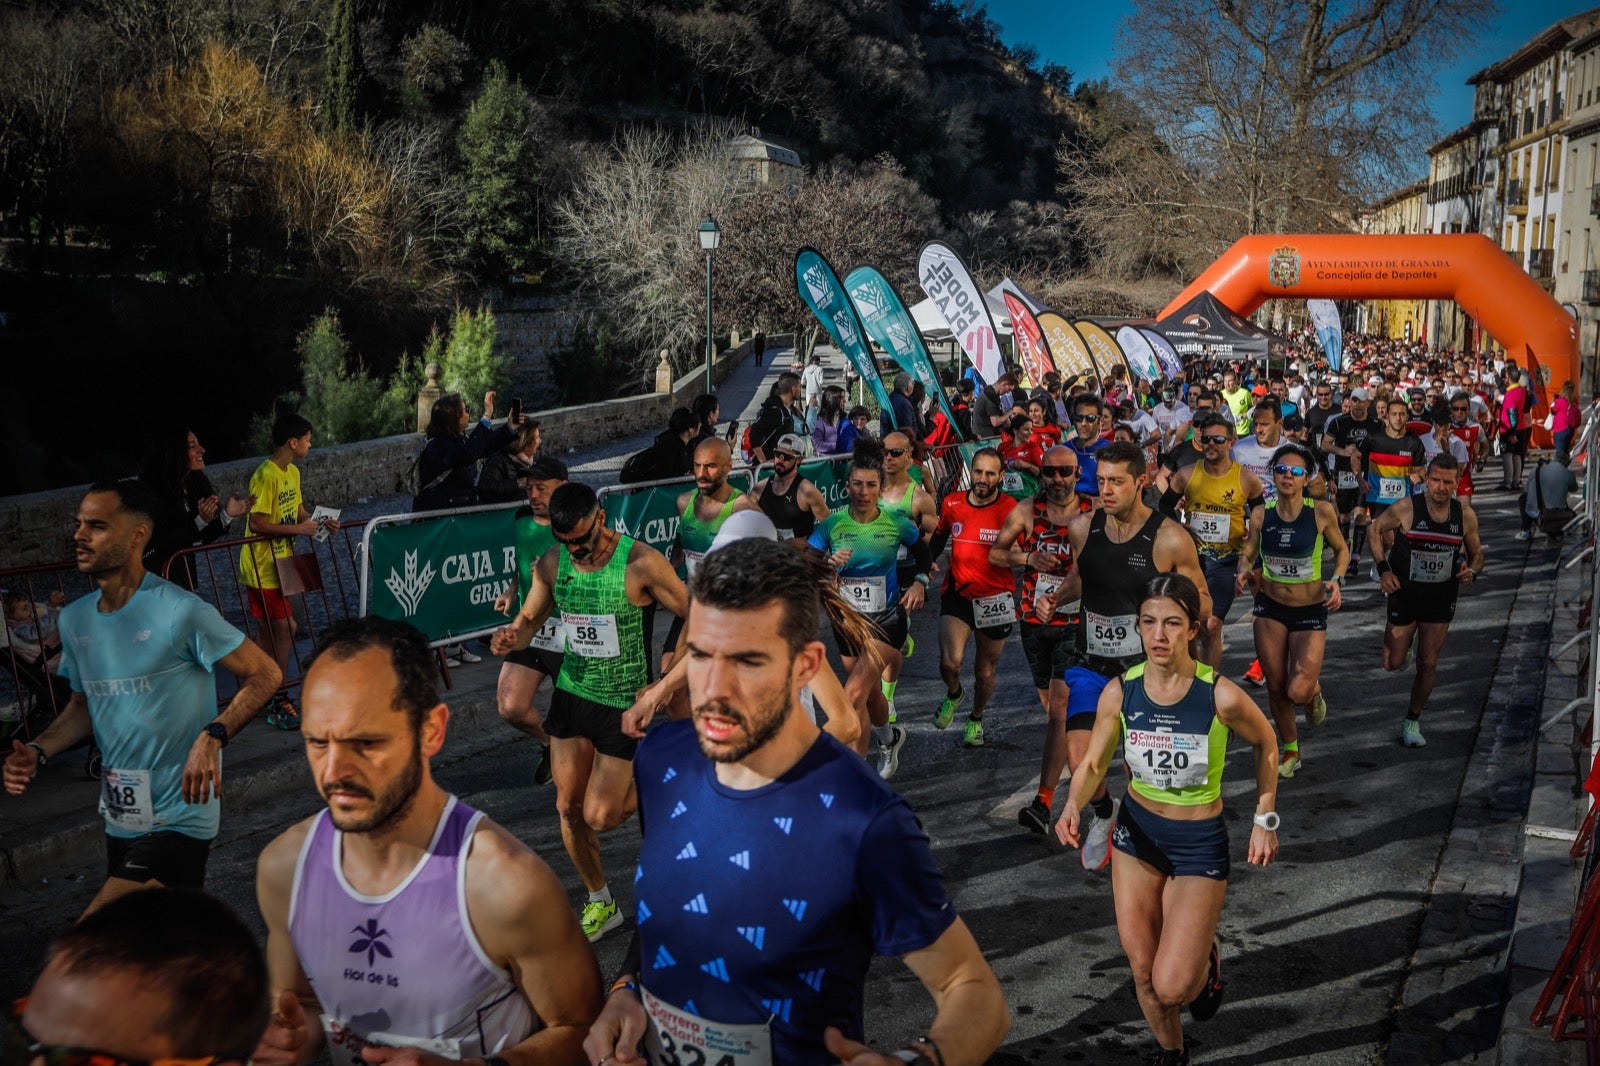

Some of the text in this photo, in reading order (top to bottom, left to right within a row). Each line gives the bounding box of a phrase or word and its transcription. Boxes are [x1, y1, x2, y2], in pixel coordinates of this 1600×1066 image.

[1306, 259, 1450, 269] AYUNTAMIENTO DE GRANADA
[1316, 269, 1438, 281] Concejalía de Deportes
[1202, 520, 1217, 531] 35
[1036, 541, 1071, 556] KEN
[441, 549, 495, 585] CAJA
[1280, 564, 1298, 574] 38
[1420, 560, 1444, 570] 309
[853, 586, 870, 598] 91
[982, 602, 1007, 615] 246
[576, 626, 598, 640] 58
[1094, 625, 1127, 641] 549
[1129, 731, 1139, 745] 9
[1138, 732, 1171, 742] Carrera
[1138, 740, 1173, 749] Solidaria
[1142, 749, 1189, 770] 120
[344, 968, 399, 988] flor de lis
[705, 1026, 723, 1036] Ave
[705, 1041, 750, 1055] Granada
